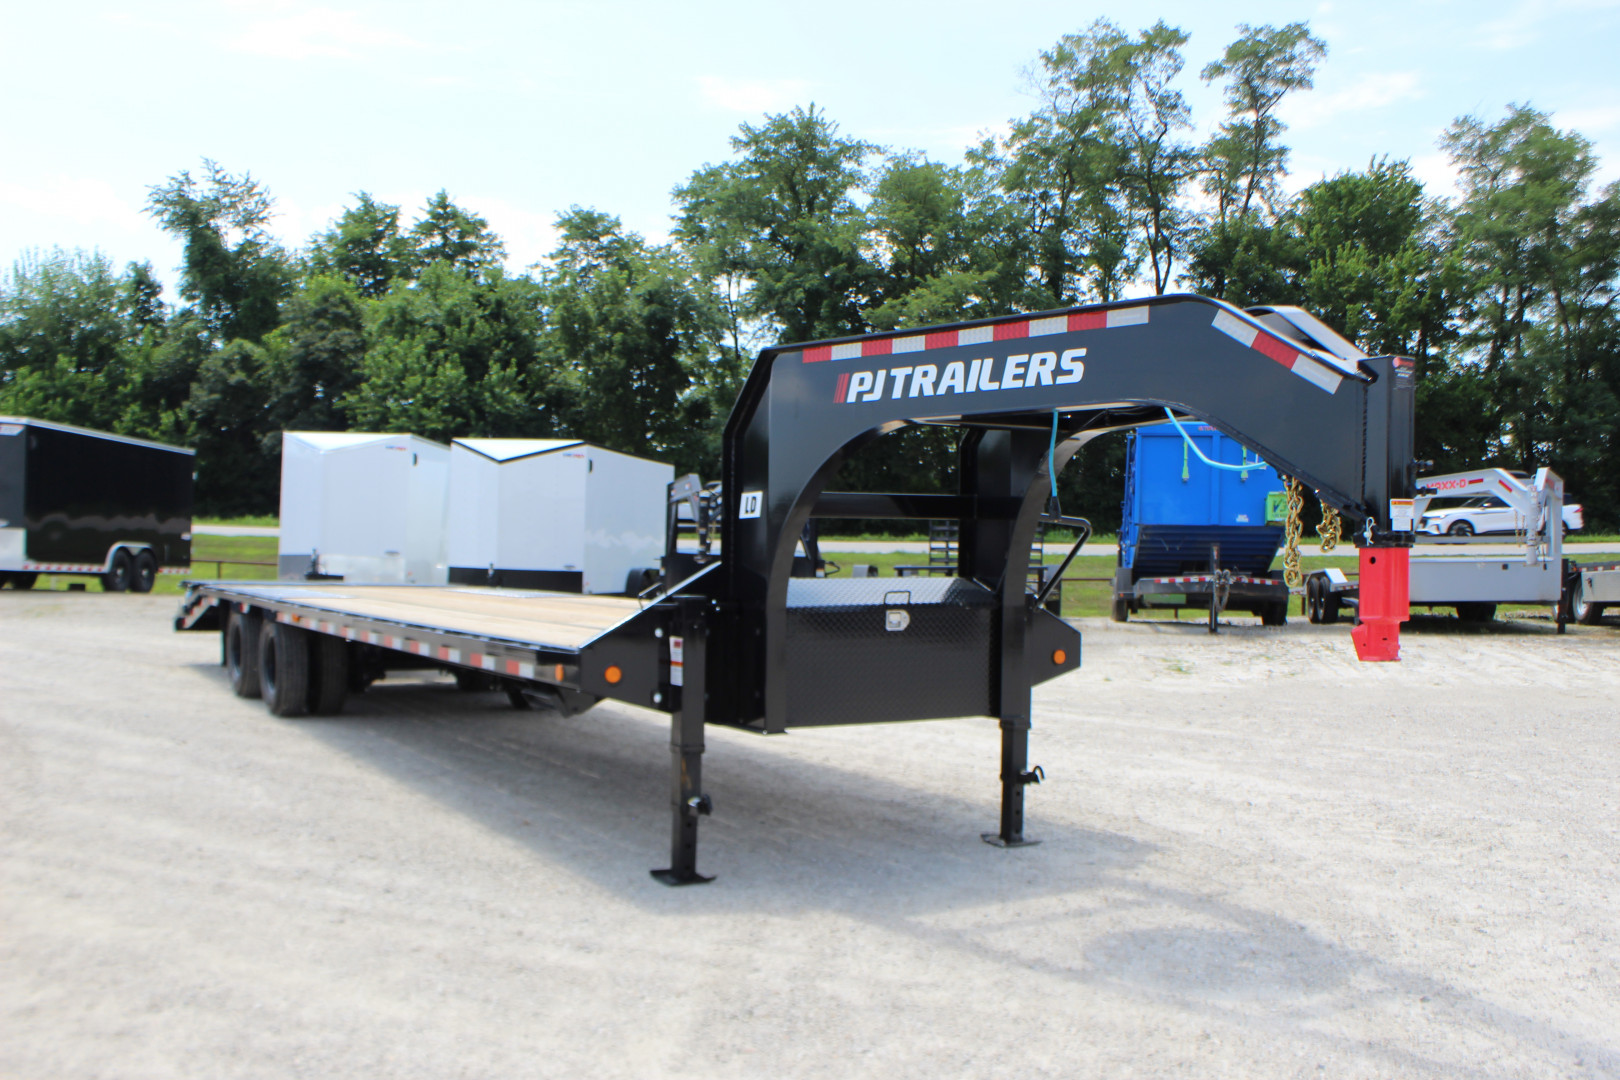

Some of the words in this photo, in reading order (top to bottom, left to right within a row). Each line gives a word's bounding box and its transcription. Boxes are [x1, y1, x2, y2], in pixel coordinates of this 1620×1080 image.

[846, 369, 887, 403] PJ
[890, 347, 1088, 400] TRAILERS
[745, 495, 757, 515] LD
